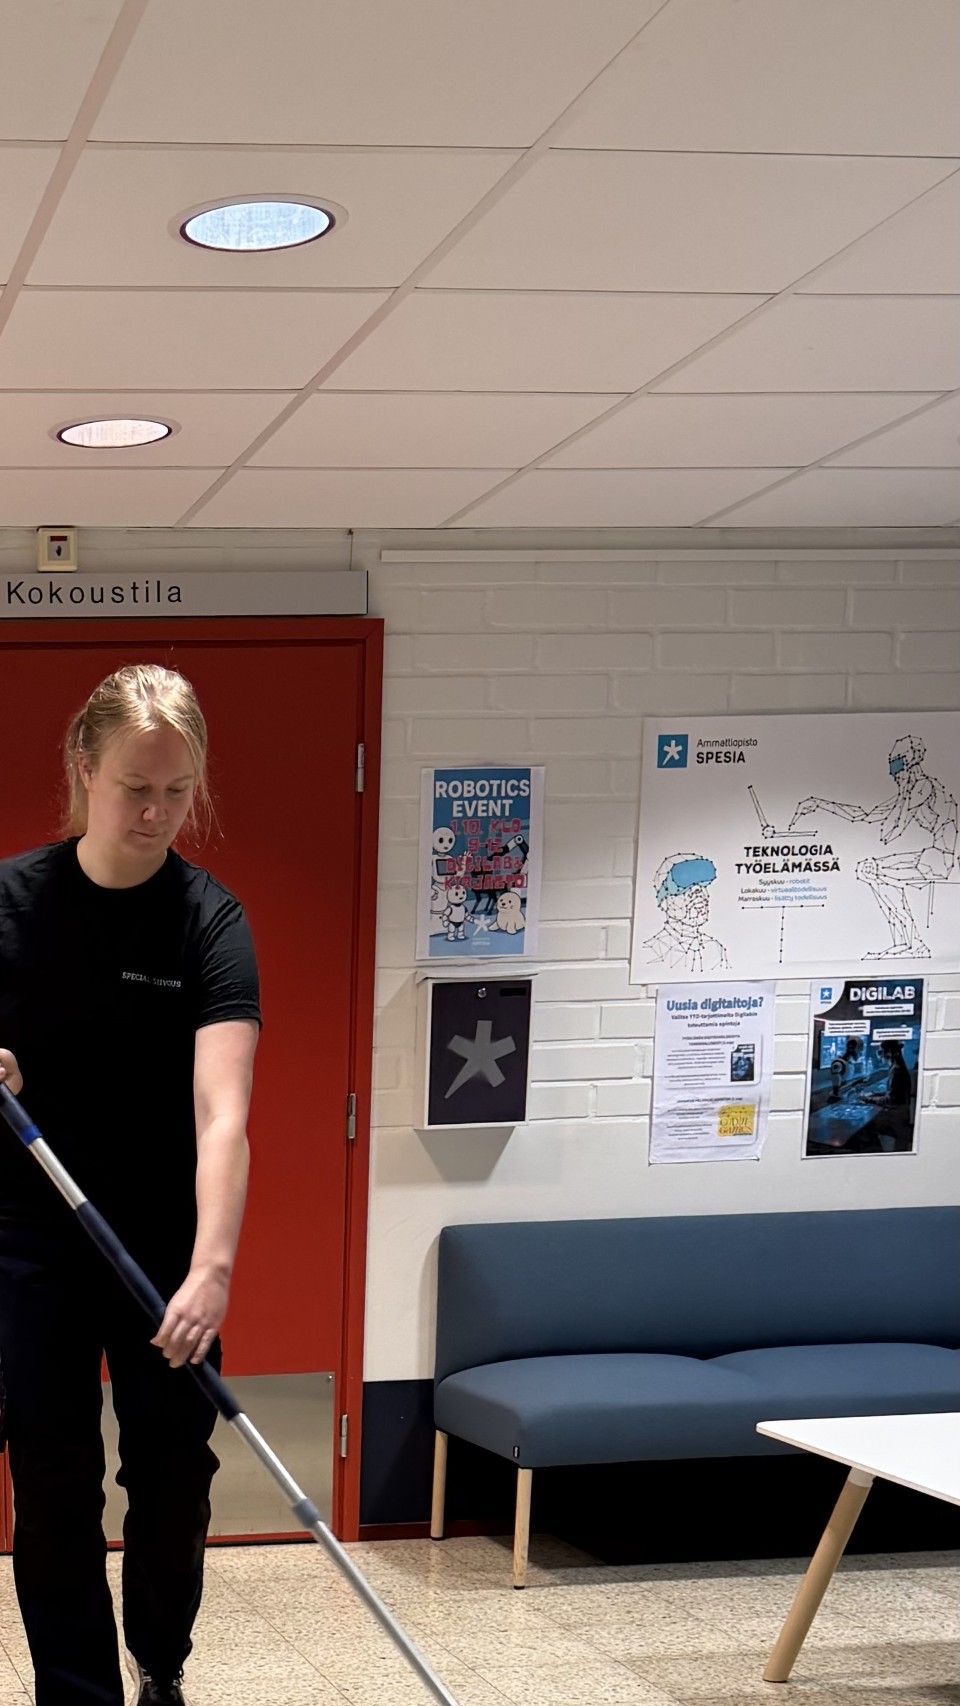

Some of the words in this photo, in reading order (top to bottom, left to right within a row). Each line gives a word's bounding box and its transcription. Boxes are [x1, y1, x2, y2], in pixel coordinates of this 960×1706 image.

[7, 580, 182, 604] Kokoustila
[697, 738, 758, 748] Ammattiopisto
[696, 751, 746, 764] SPESIA
[435, 780, 530, 798] ROBOTICS
[452, 800, 513, 817] EVENT
[744, 845, 833, 857] TEKNOLOGIA
[735, 858, 841, 874] TYÖELÄMÄSSÄ
[667, 999, 698, 1011] Uusia
[700, 996, 764, 1012] digitaitoja?
